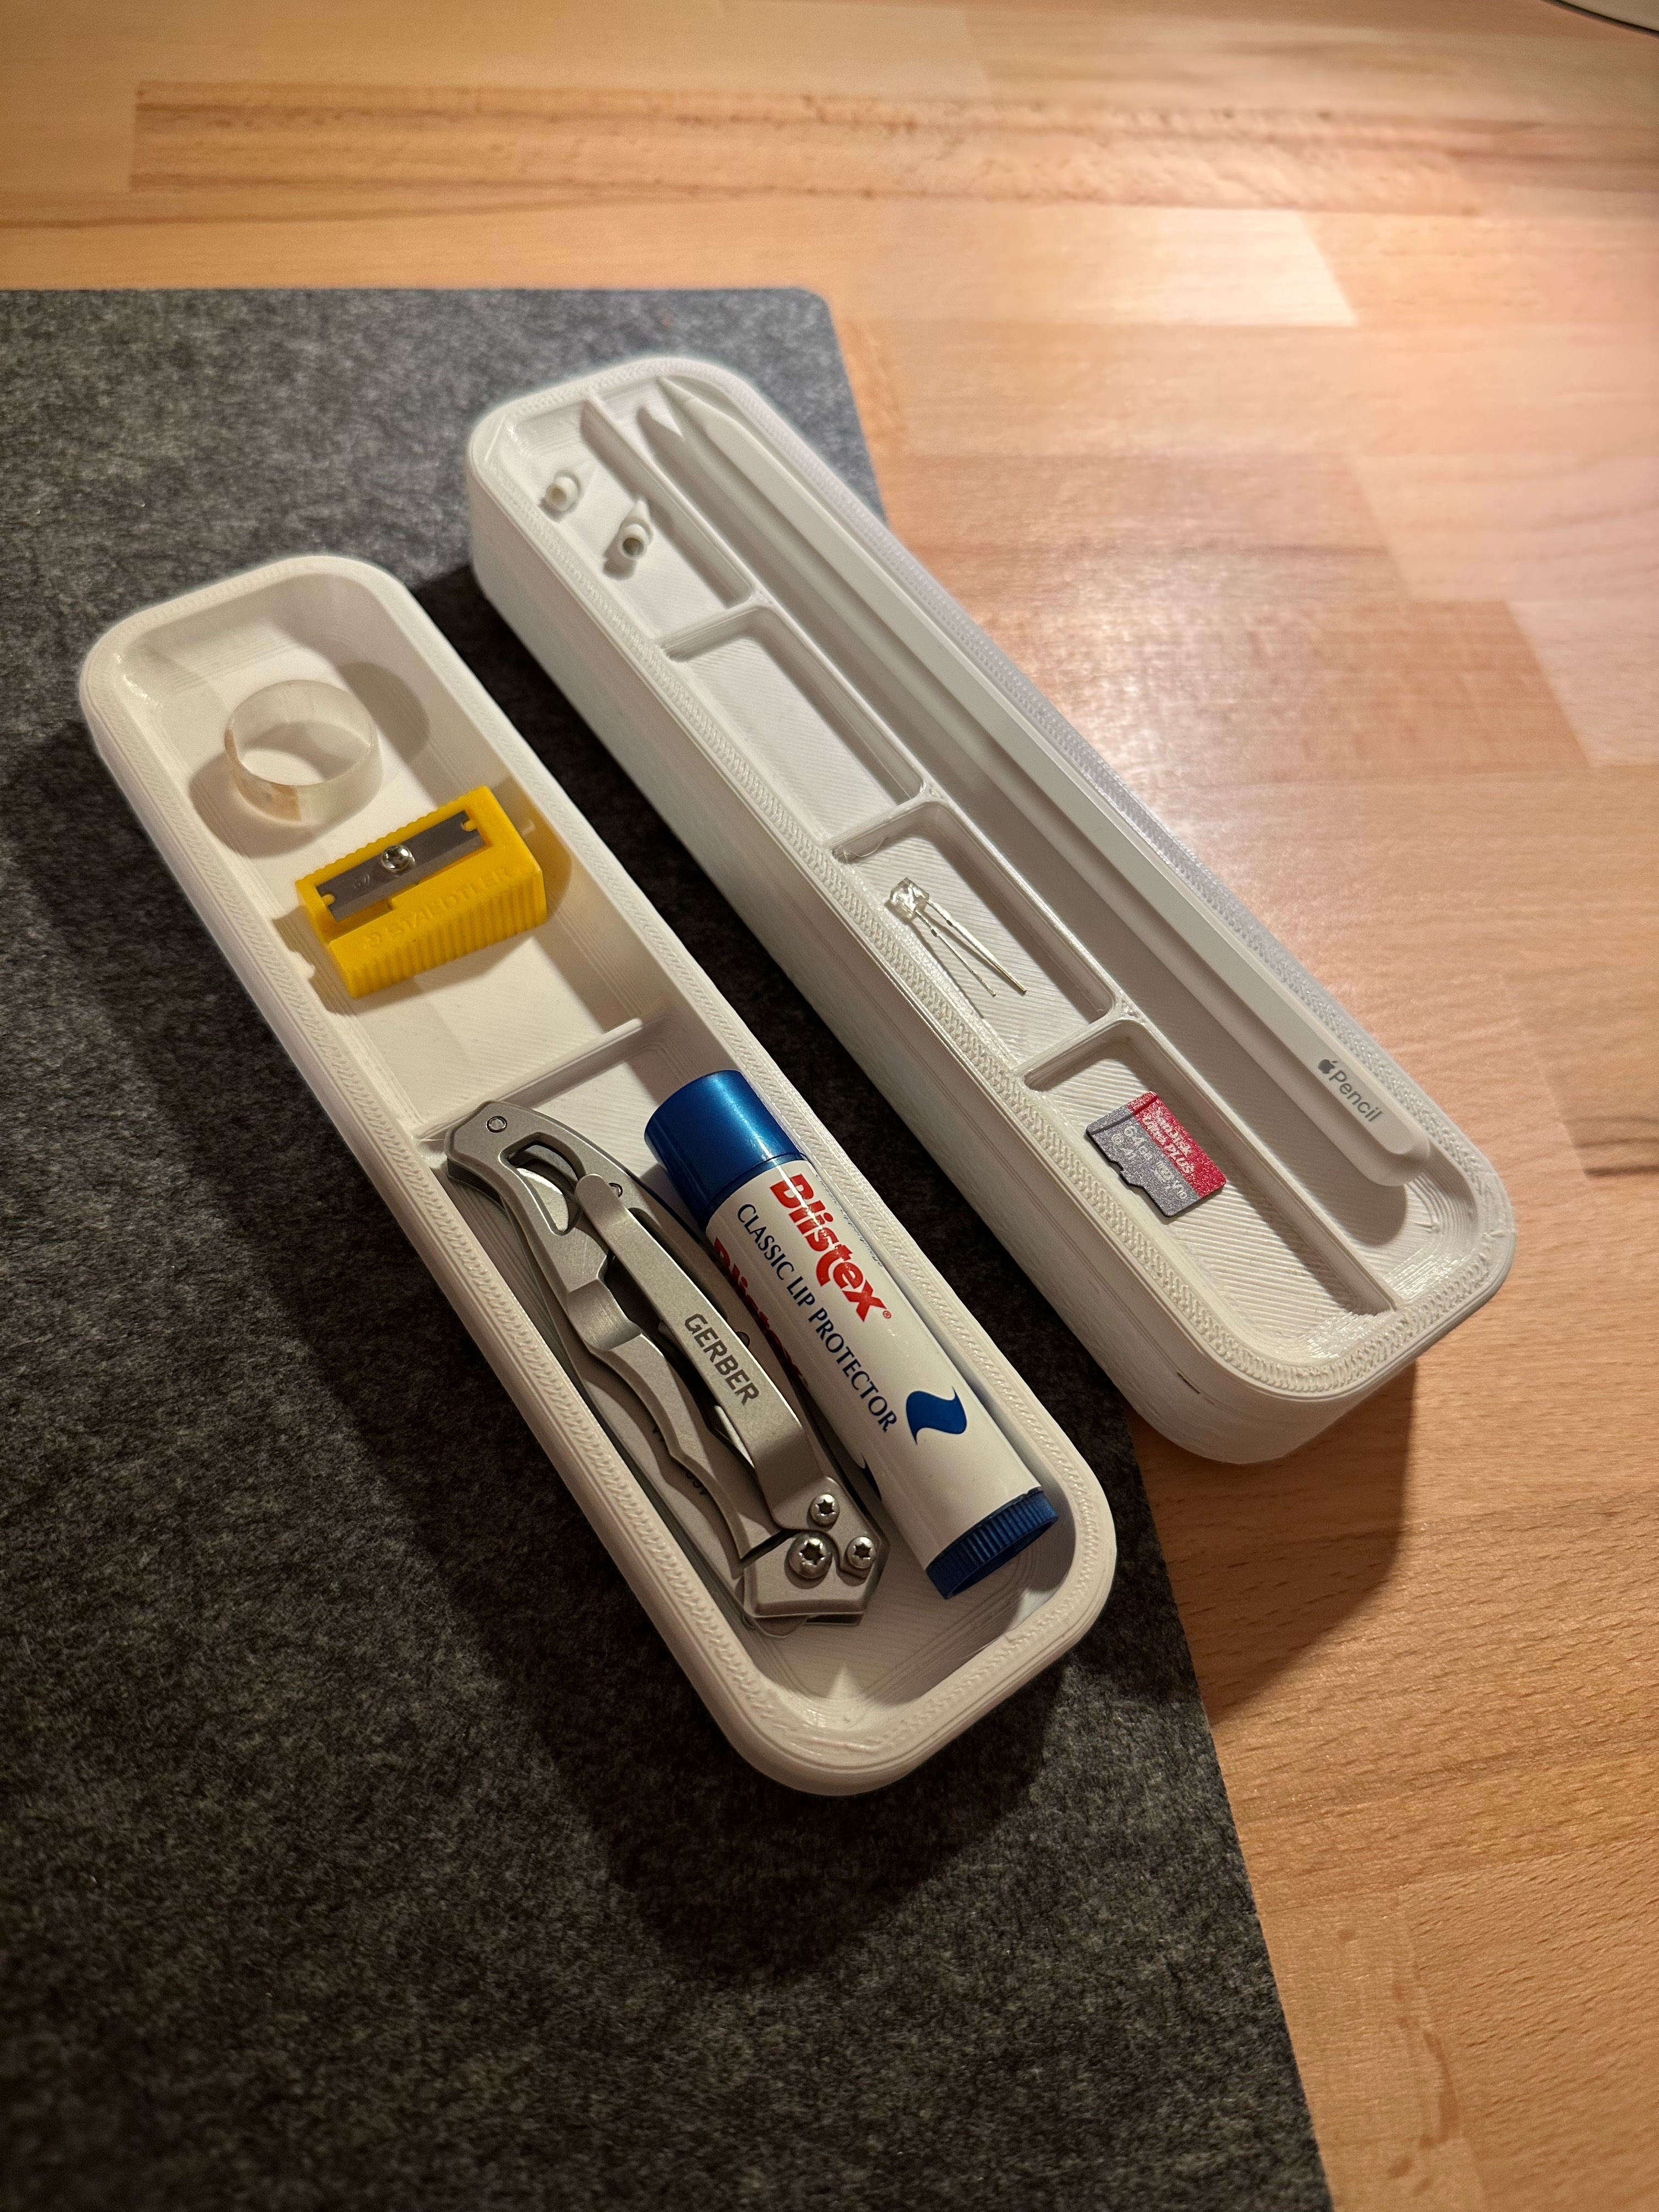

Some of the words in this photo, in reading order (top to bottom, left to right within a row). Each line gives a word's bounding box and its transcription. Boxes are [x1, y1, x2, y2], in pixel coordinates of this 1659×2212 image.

[1328, 1069, 1383, 1122] Pencil
[1164, 1143, 1195, 1174] PLUS
[737, 1204, 795, 1281] CLASSIC
[787, 1276, 815, 1307] LIP
[808, 1307, 898, 1433] PROTECTOR
[684, 1313, 760, 1406] GERBER
